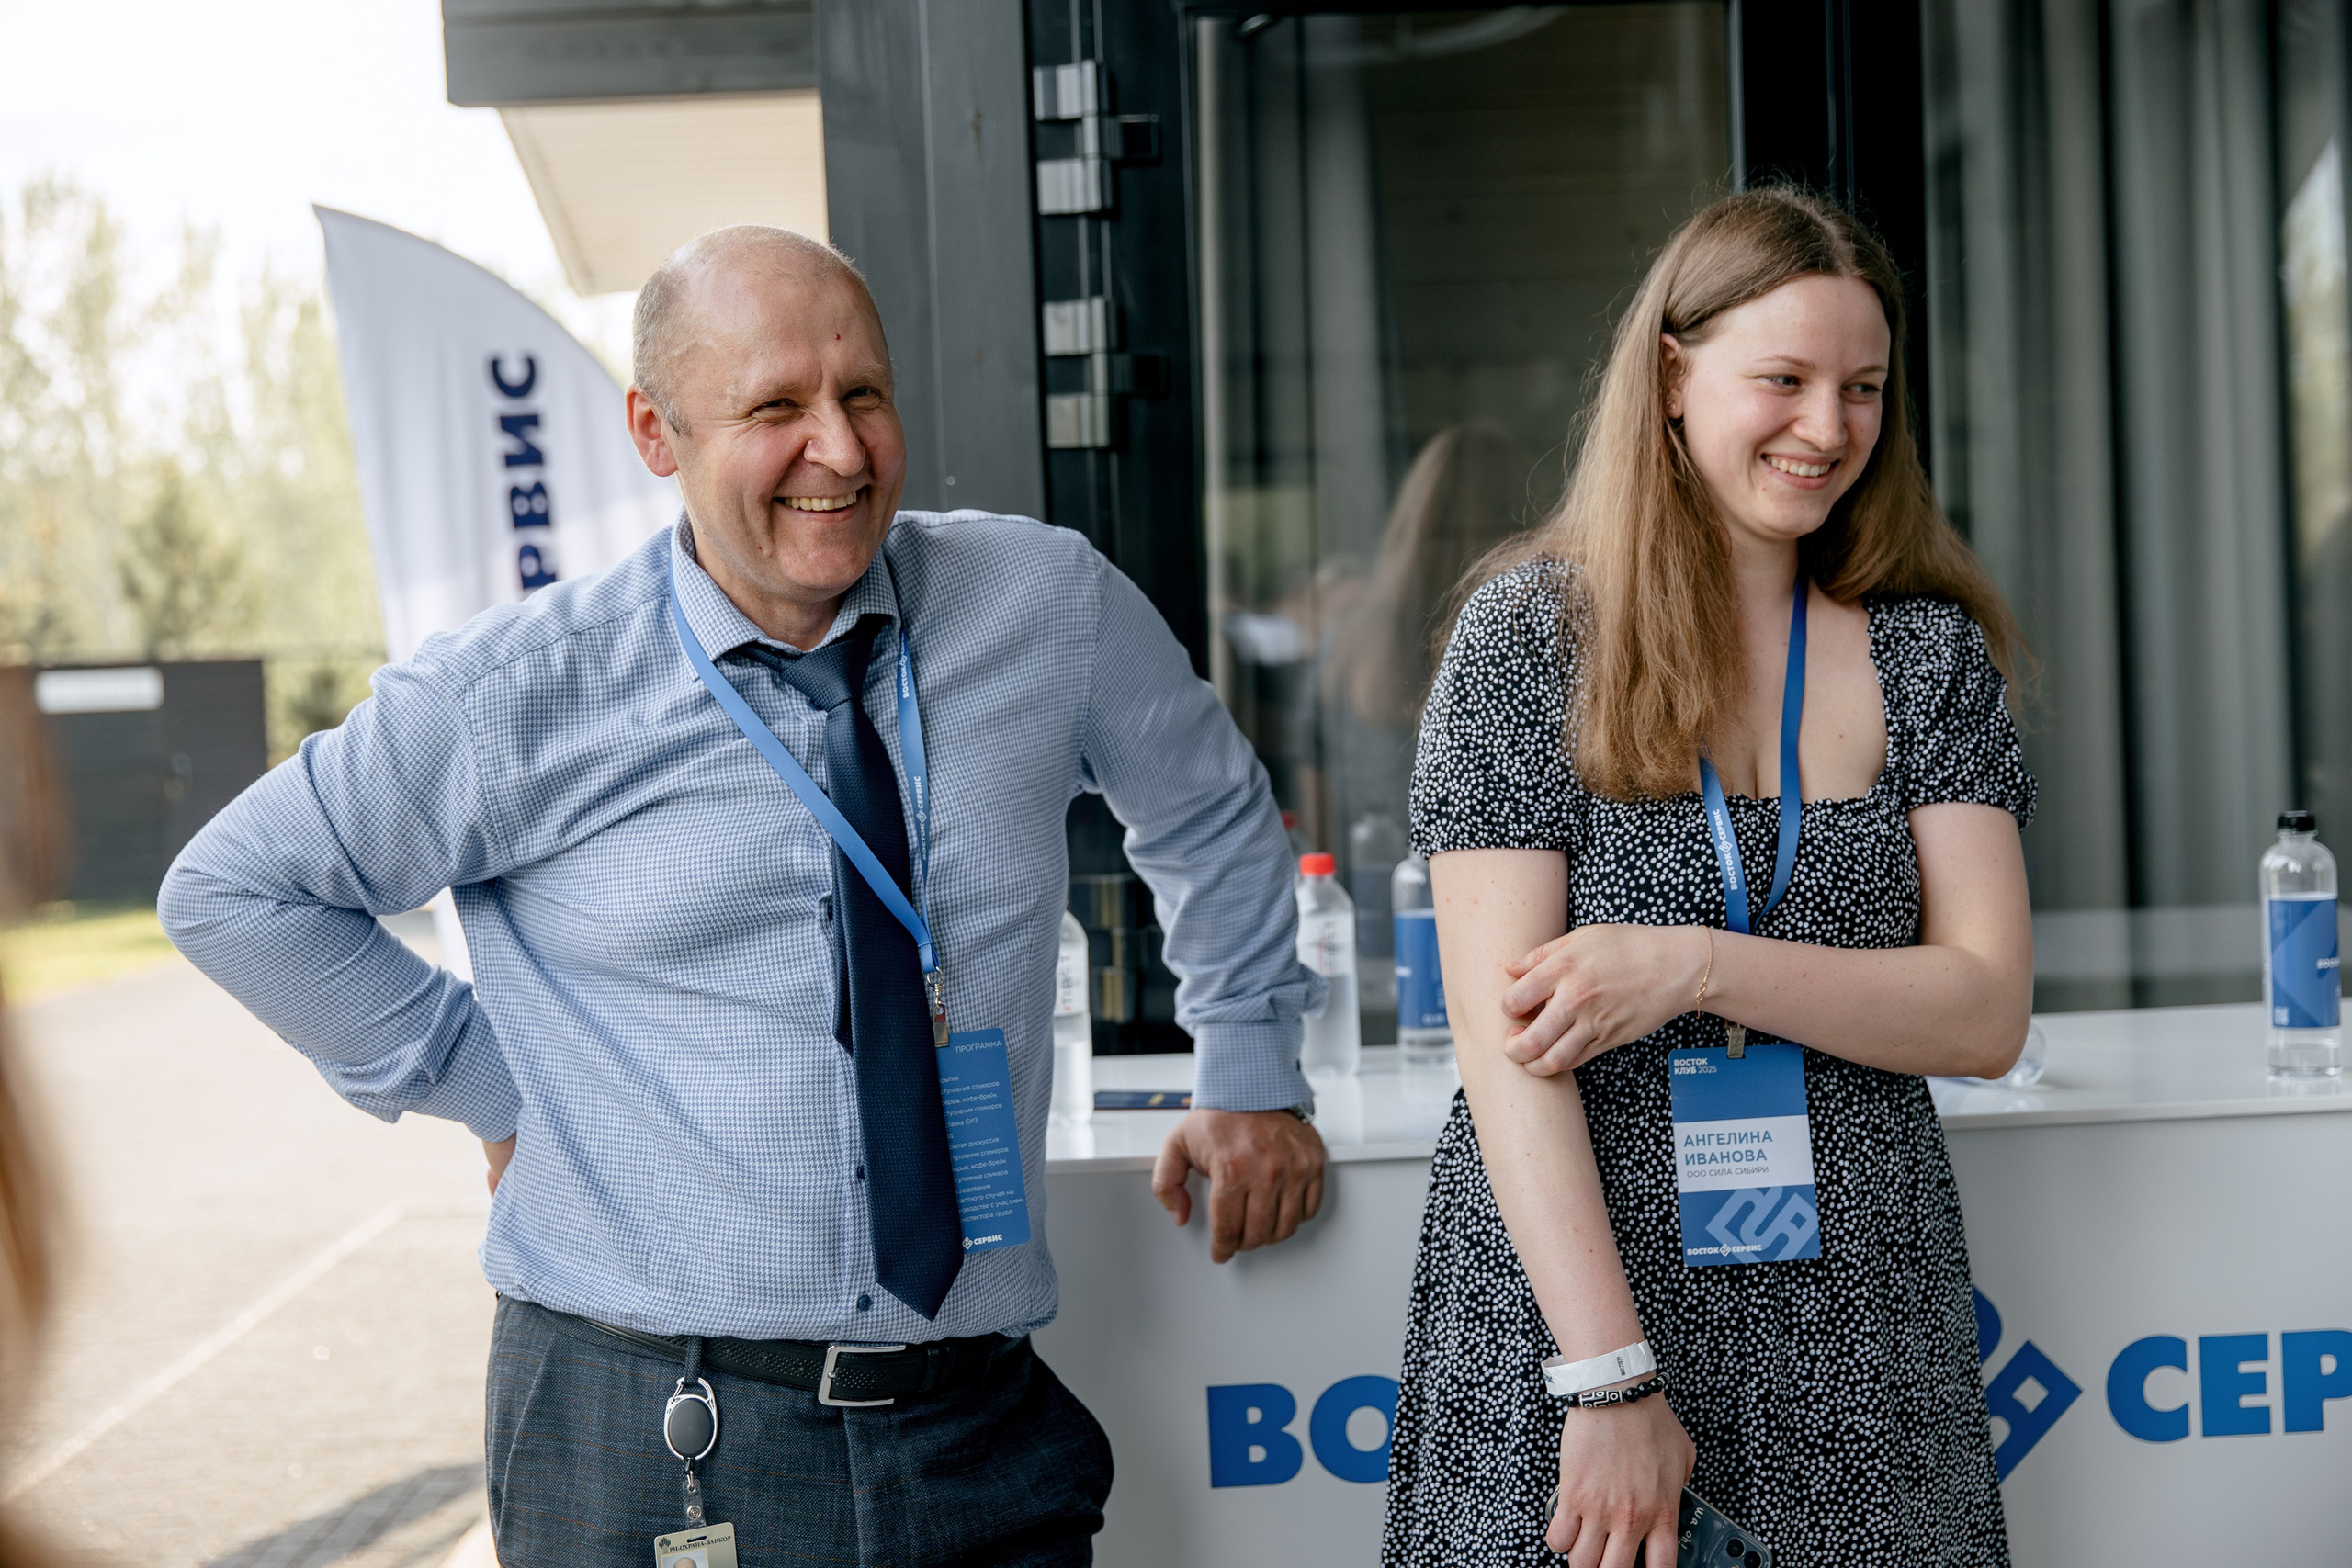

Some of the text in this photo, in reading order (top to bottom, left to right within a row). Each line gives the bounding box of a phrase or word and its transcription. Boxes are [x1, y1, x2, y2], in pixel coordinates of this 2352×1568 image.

[913, 775, 923, 809] СЕРВИС
[1713, 808, 1738, 891] ВОСТОК СЕРВИС
[956, 1040, 1002, 1053] ПРОГРАММА
[1673, 1057, 1708, 1066] ВОСТОК
[1674, 1066, 1717, 1075] КЛУБ 2025
[940, 1076, 959, 1084] рытие
[971, 1081, 1000, 1090] спикеров
[962, 1092, 998, 1102] кофе-брейк
[974, 1103, 1002, 1111] спикеров
[965, 1117, 978, 1125] СИЗ
[968, 1137, 1000, 1147] дискуссия
[1683, 1130, 1773, 1147] АНГЕЛИНА
[951, 1147, 1009, 1161] тупления спикеров
[1685, 1148, 1768, 1166] ИВАНОВА
[971, 1158, 1006, 1168] кофе-брейк
[983, 1169, 1009, 1179] спикера
[1687, 1166, 1770, 1178] ООО СИЛА СИБИРИ
[985, 1191, 1006, 1200] случая
[995, 1198, 1023, 1208] участием
[994, 1209, 1012, 1217] труда
[974, 1234, 1003, 1246] СЕРВИС
[1686, 1244, 1762, 1256] ВОСТОК СЕРВИС
[2107, 1328, 2352, 1442] СЕР
[669, 1536, 732, 1552] РН-ОХРАНА-ВАНКОР
